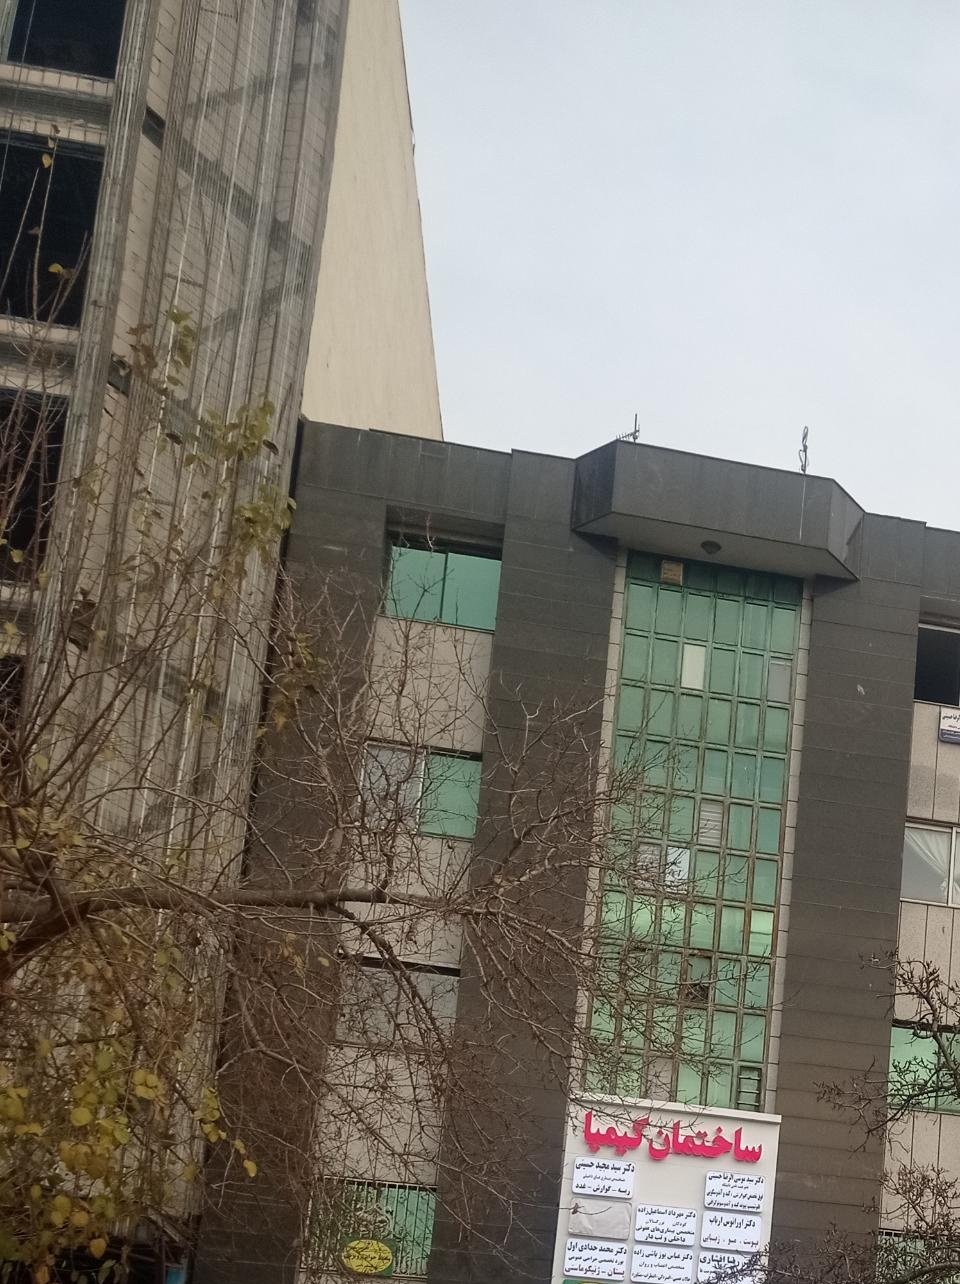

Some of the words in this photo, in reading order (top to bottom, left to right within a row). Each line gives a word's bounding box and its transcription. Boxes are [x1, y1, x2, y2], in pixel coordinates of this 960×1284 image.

[584, 1110, 649, 1156] کیمیا
[649, 1120, 762, 1163] ساختمان
[576, 1158, 594, 1170] حسینی
[622, 1163, 634, 1174] دکتر
[684, 1211, 696, 1220] دکتر
[744, 1220, 756, 1229] دکتر
[614, 1247, 627, 1256] دکتر
[681, 1253, 693, 1261] دکتر
